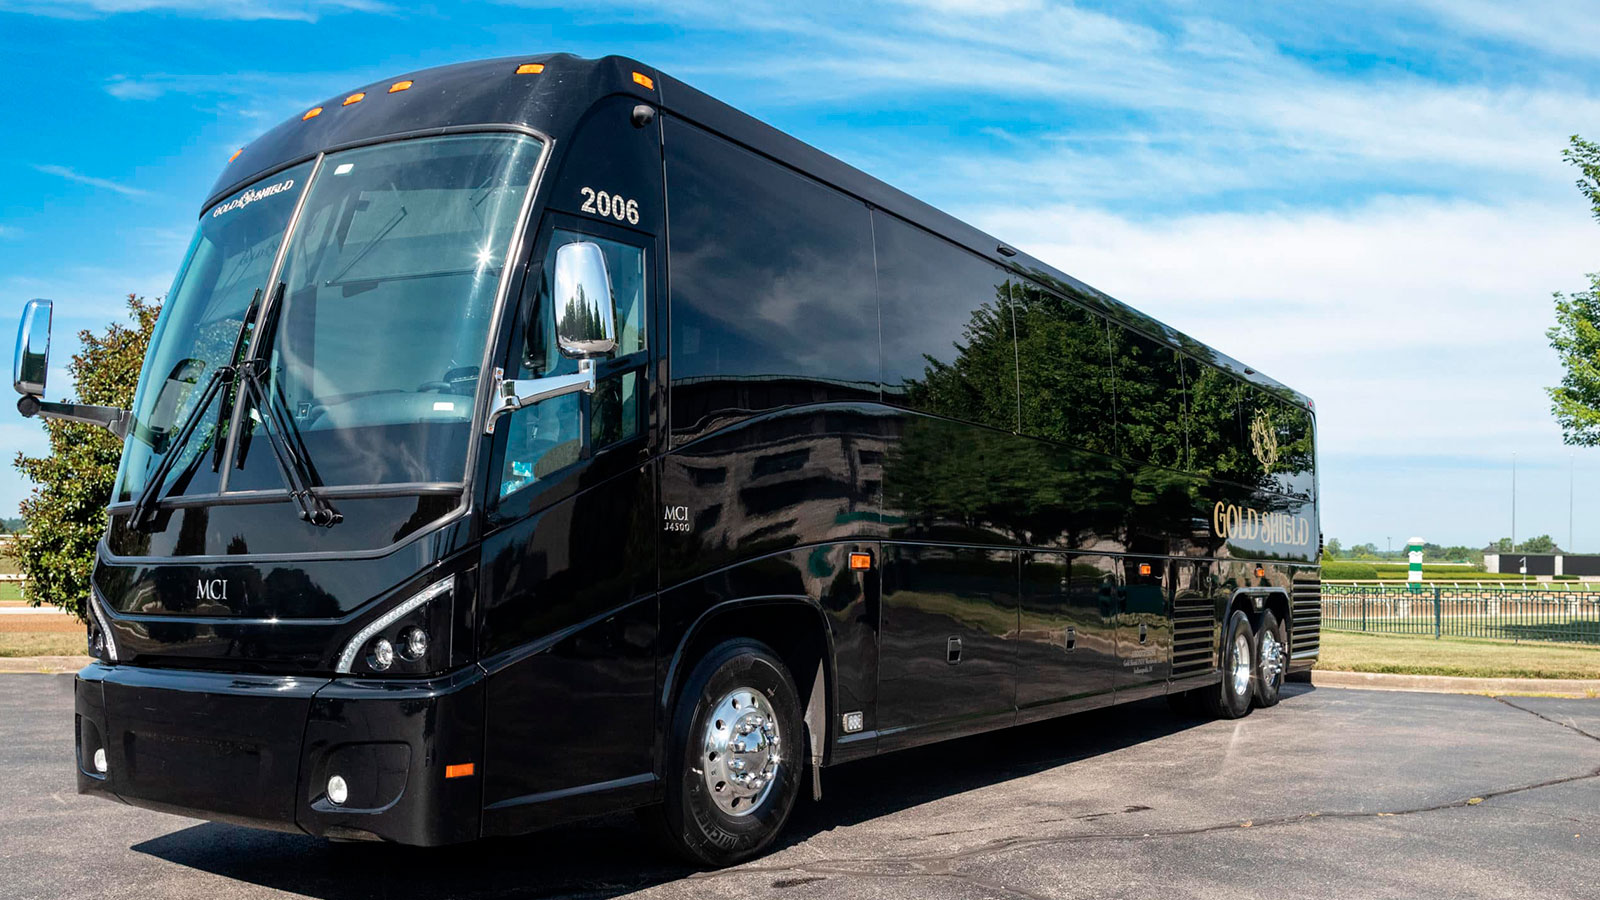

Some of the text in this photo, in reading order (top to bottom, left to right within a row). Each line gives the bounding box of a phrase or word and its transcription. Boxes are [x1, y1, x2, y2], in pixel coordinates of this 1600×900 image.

[213, 198, 239, 218] GOLD
[254, 179, 295, 202] SHIELD
[580, 186, 640, 225] 2006
[663, 522, 690, 532] J4500
[664, 505, 689, 521] MCI
[1213, 501, 1310, 546] GOLD SHIELD
[196, 578, 228, 600] MCI
